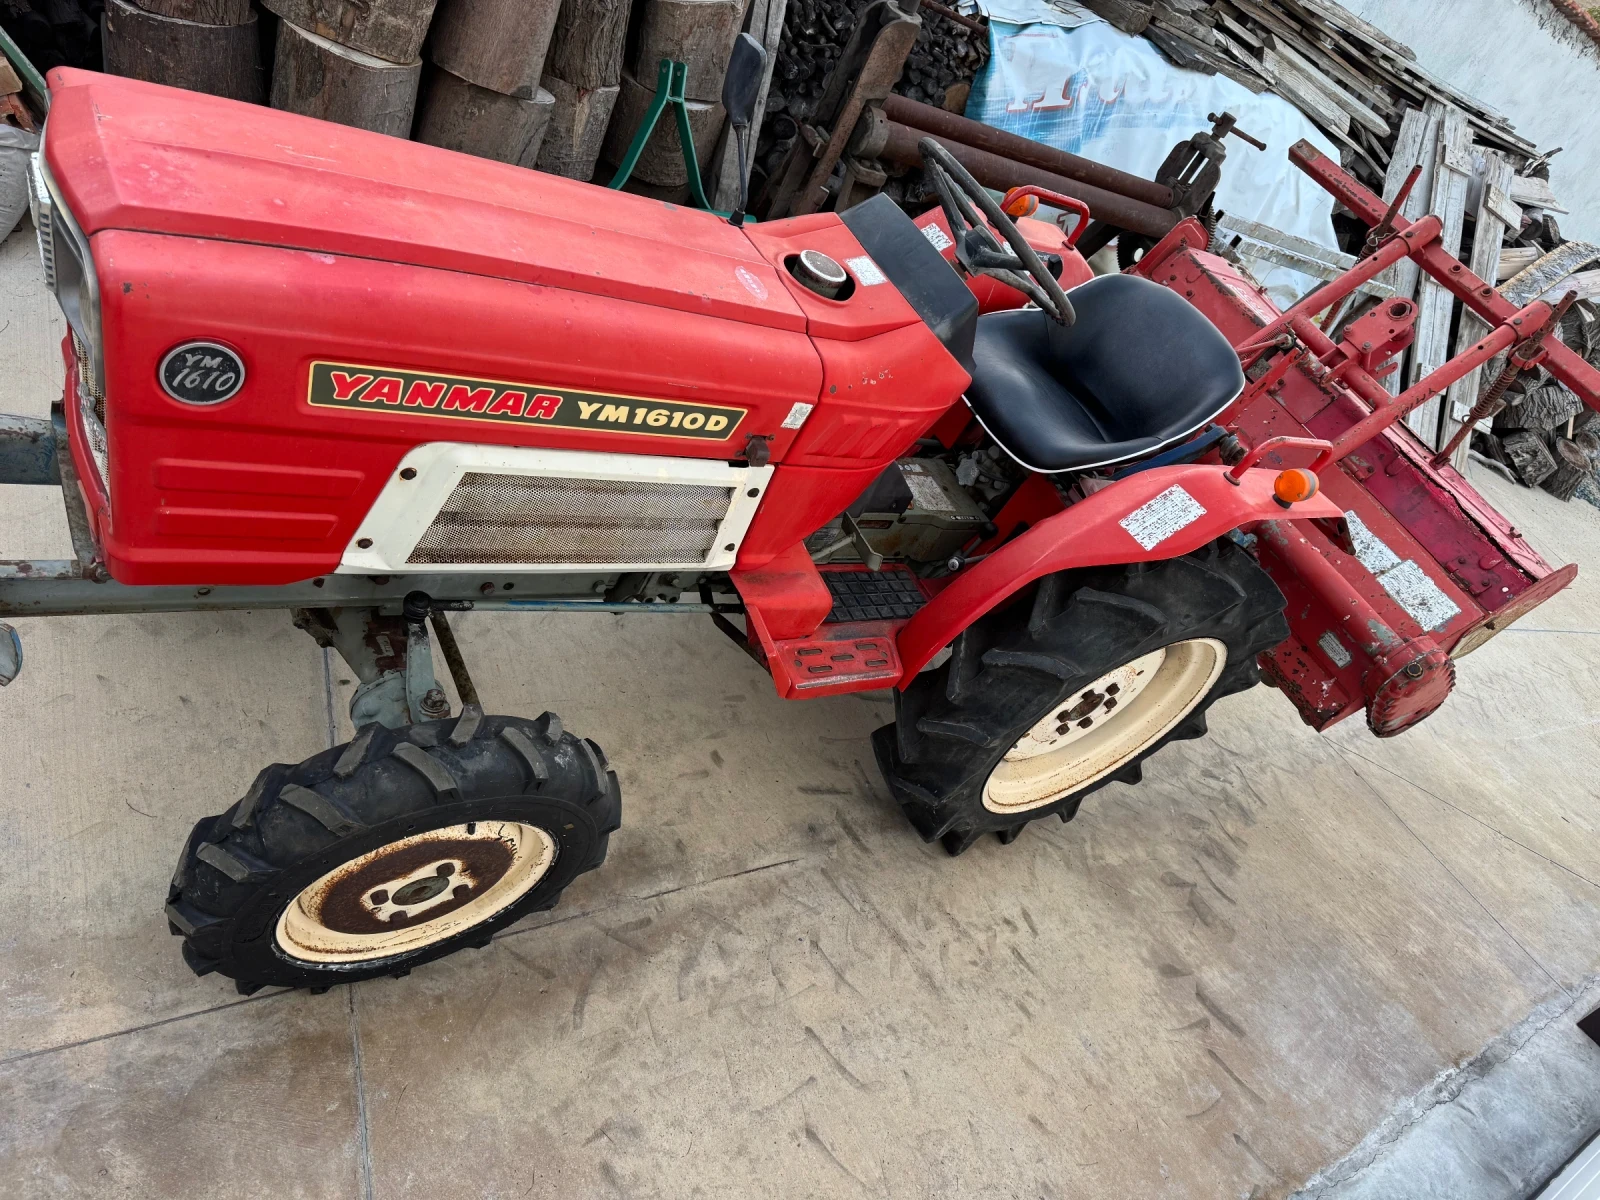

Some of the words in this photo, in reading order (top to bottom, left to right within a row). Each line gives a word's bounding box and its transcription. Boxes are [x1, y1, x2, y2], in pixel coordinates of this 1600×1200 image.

[185, 354, 223, 368] YM
[172, 368, 236, 391] 1610
[330, 371, 563, 420] YANMAR
[577, 401, 729, 432] YM1610D
